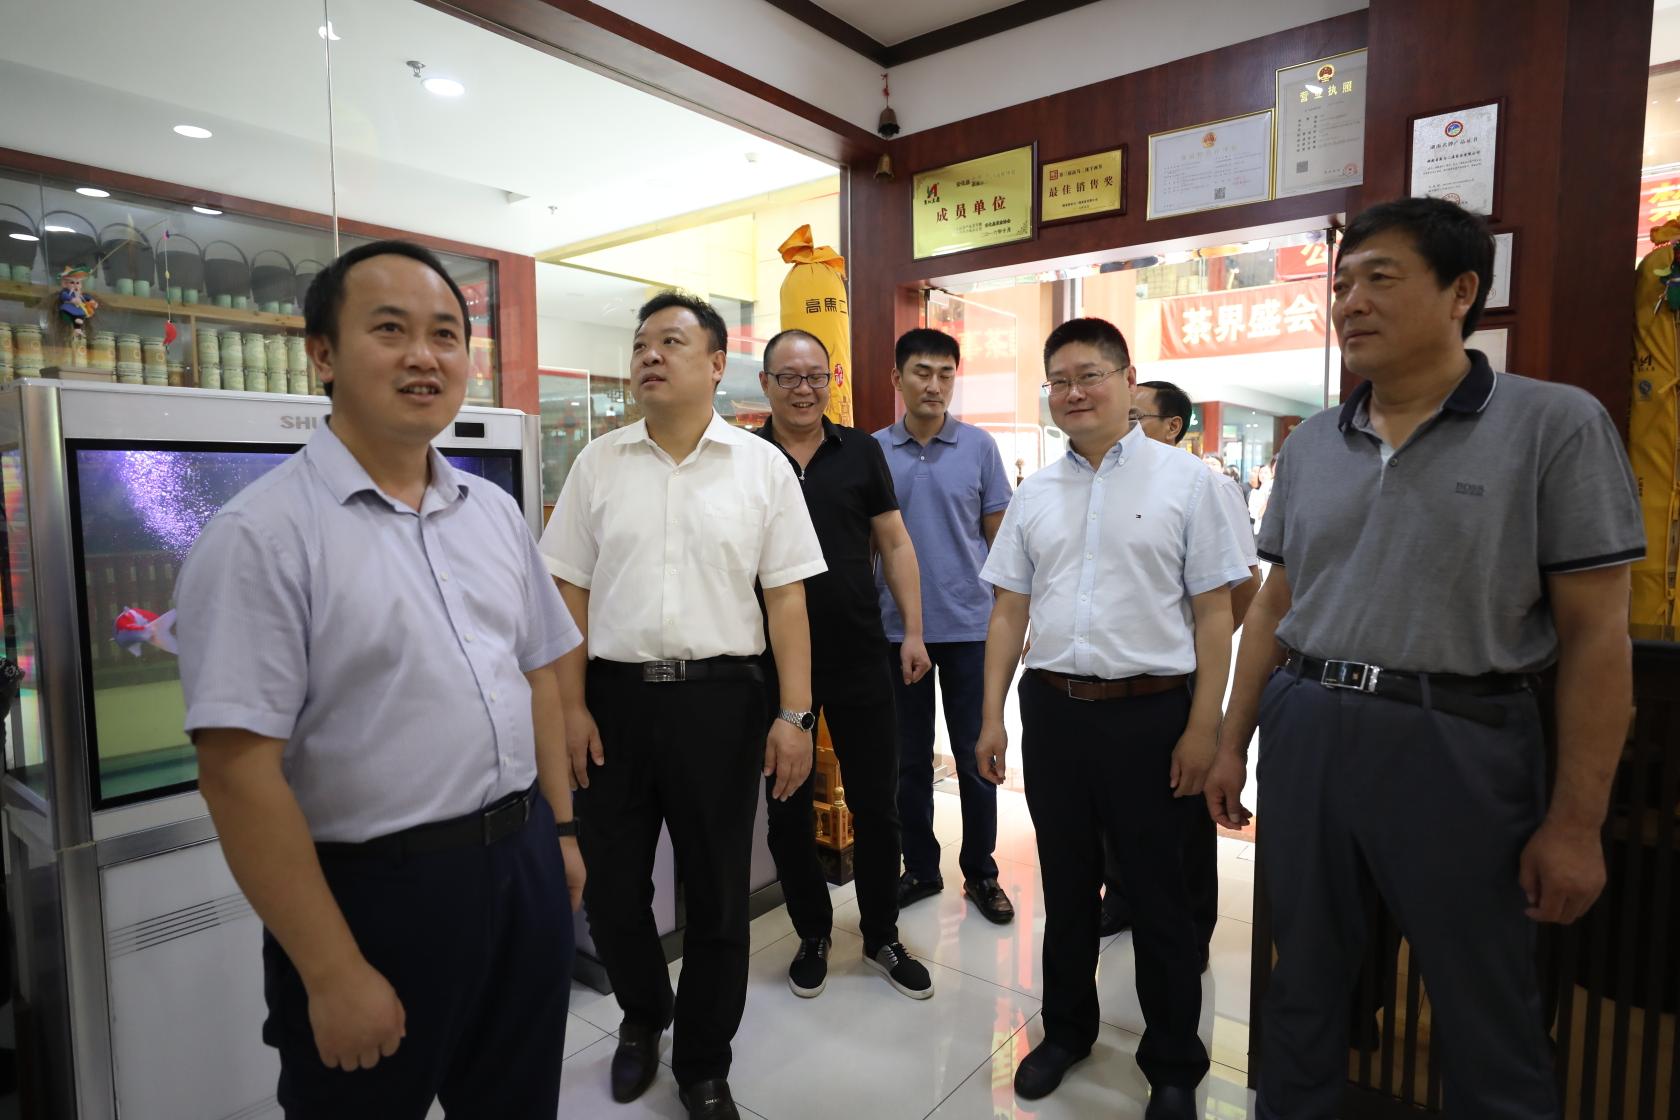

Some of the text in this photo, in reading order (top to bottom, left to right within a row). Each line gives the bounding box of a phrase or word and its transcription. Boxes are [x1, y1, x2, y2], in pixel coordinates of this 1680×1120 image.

[1049, 175, 1113, 198] 最佳销售奖
[936, 195, 1006, 222] 成员单位
[1182, 294, 1318, 345] 茶界盛会
